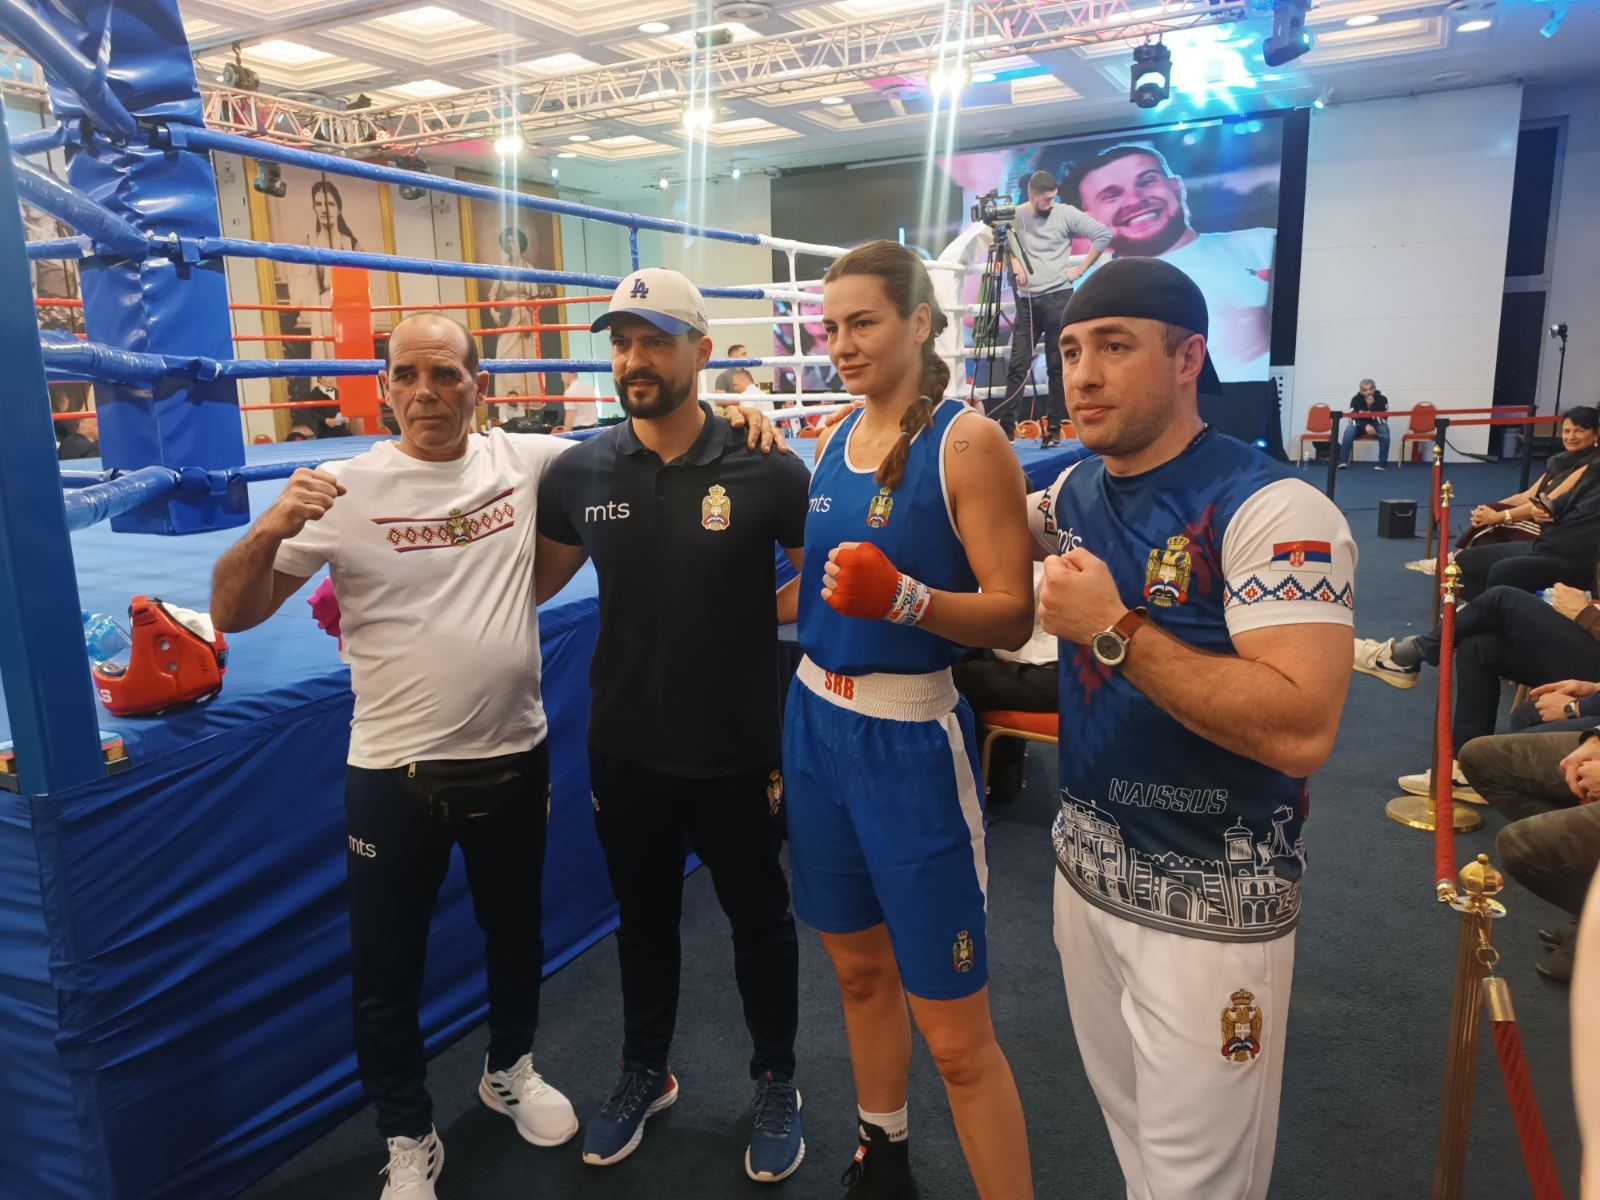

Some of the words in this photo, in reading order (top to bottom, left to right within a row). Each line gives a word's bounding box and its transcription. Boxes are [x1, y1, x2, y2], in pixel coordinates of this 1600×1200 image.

[630, 278, 649, 299] LA
[585, 500, 631, 523] mts
[808, 494, 832, 513] mts
[824, 671, 855, 701] SRB
[1108, 777, 1229, 815] NAISSUS
[348, 834, 377, 858] mts
